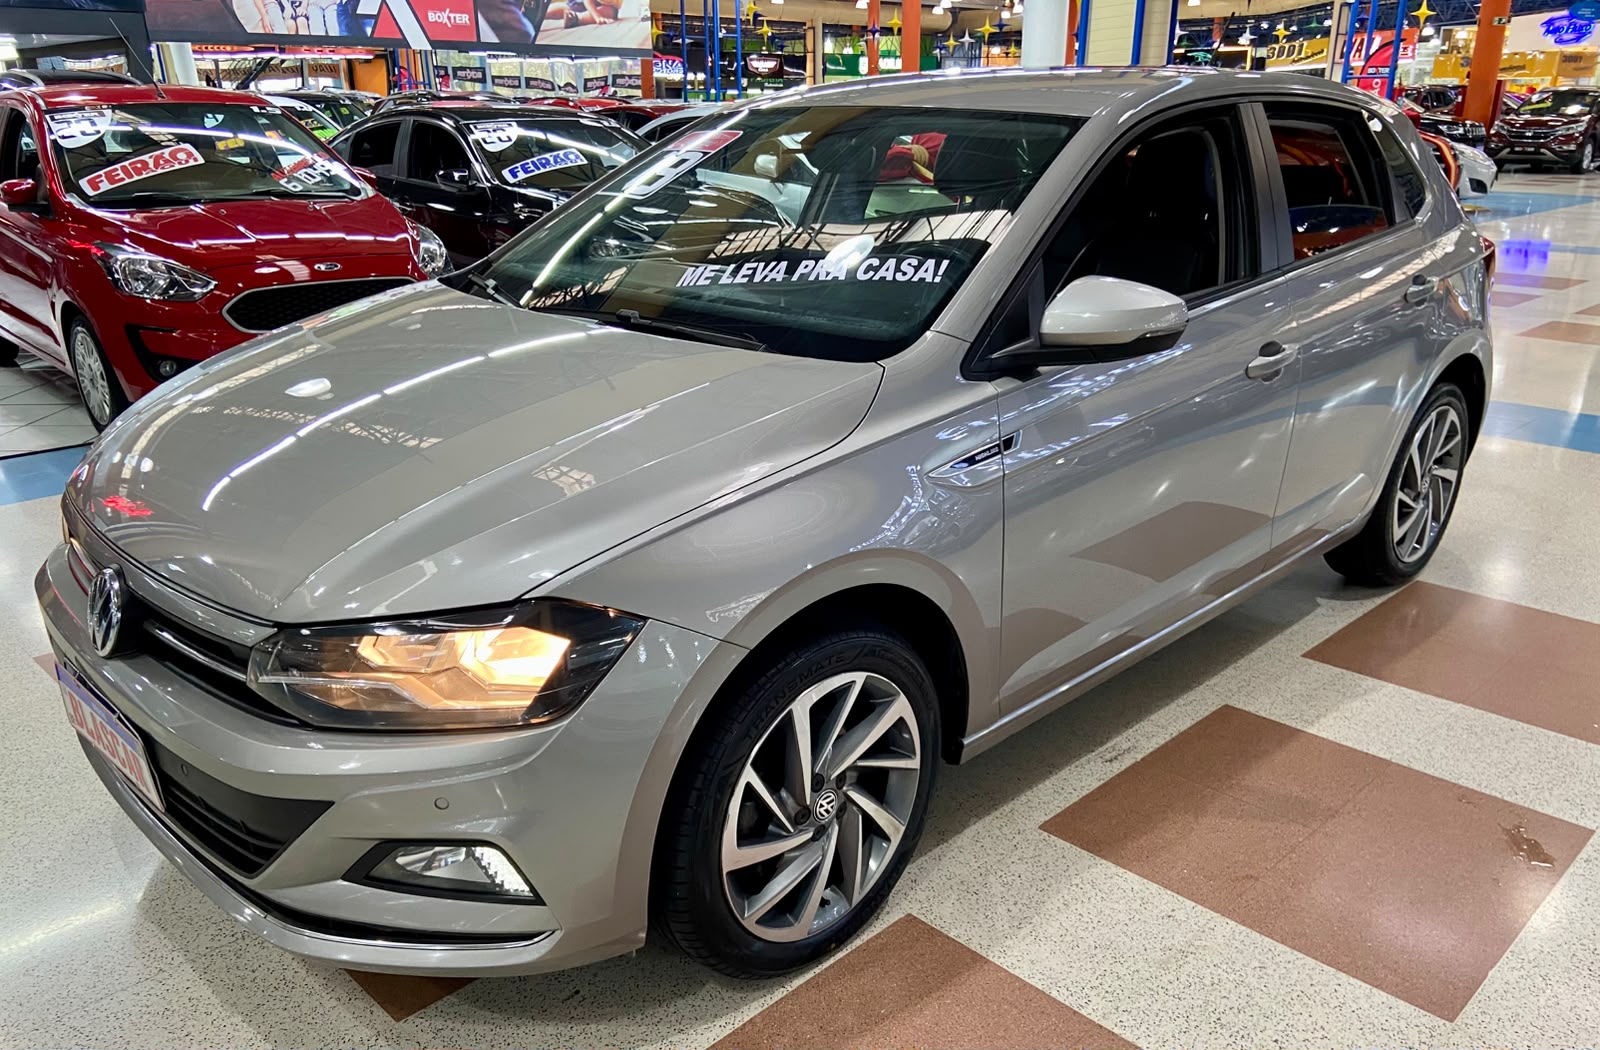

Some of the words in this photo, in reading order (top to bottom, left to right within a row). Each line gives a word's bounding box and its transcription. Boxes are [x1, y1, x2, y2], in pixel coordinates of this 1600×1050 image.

[428, 9, 470, 27] BOXTER
[1266, 42, 1305, 60] 3001
[86, 147, 195, 193] FEIRÃO
[508, 150, 581, 180] FEIRÃO
[676, 264, 720, 288] ME
[718, 260, 785, 285] LEVA
[791, 258, 848, 282] PRA
[856, 257, 950, 284] CASA!
